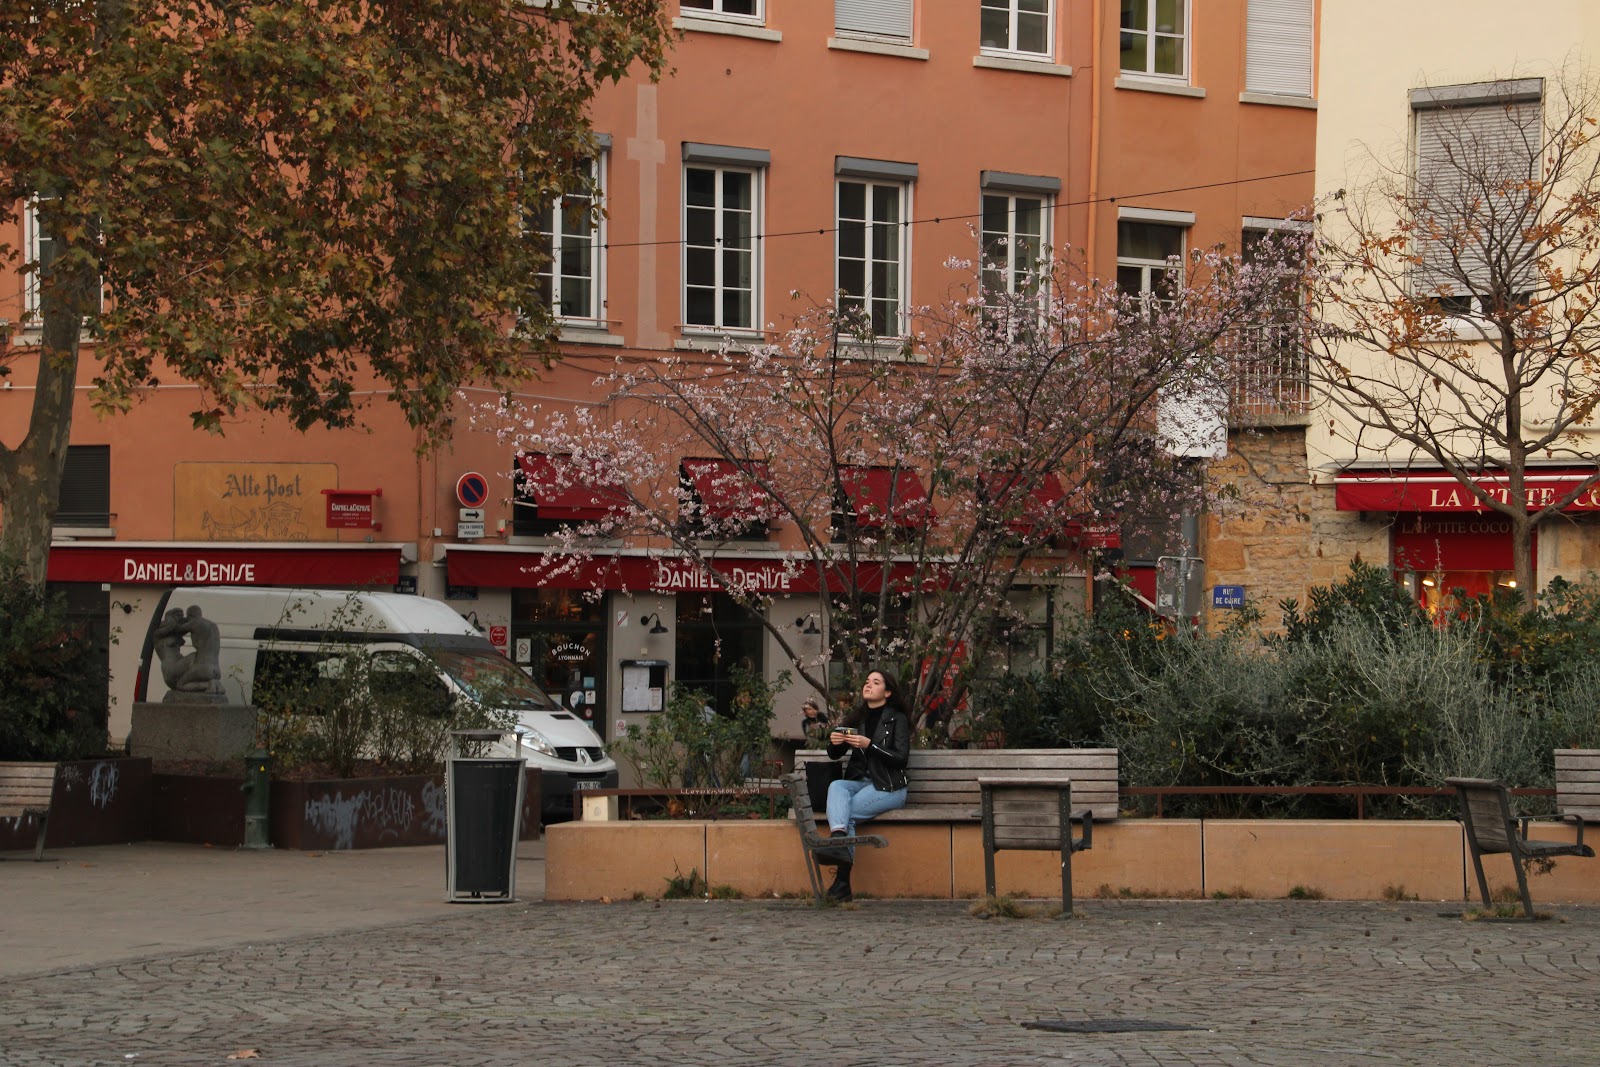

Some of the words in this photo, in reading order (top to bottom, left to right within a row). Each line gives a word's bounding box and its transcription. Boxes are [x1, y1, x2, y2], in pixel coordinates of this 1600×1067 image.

[222, 473, 260, 499] Alte
[262, 473, 303, 503] Post
[1429, 488, 1462, 507] LA
[1472, 487, 1556, 507] 'TTE
[1215, 597, 1223, 605] DE
[551, 642, 591, 657] BOUCHON
